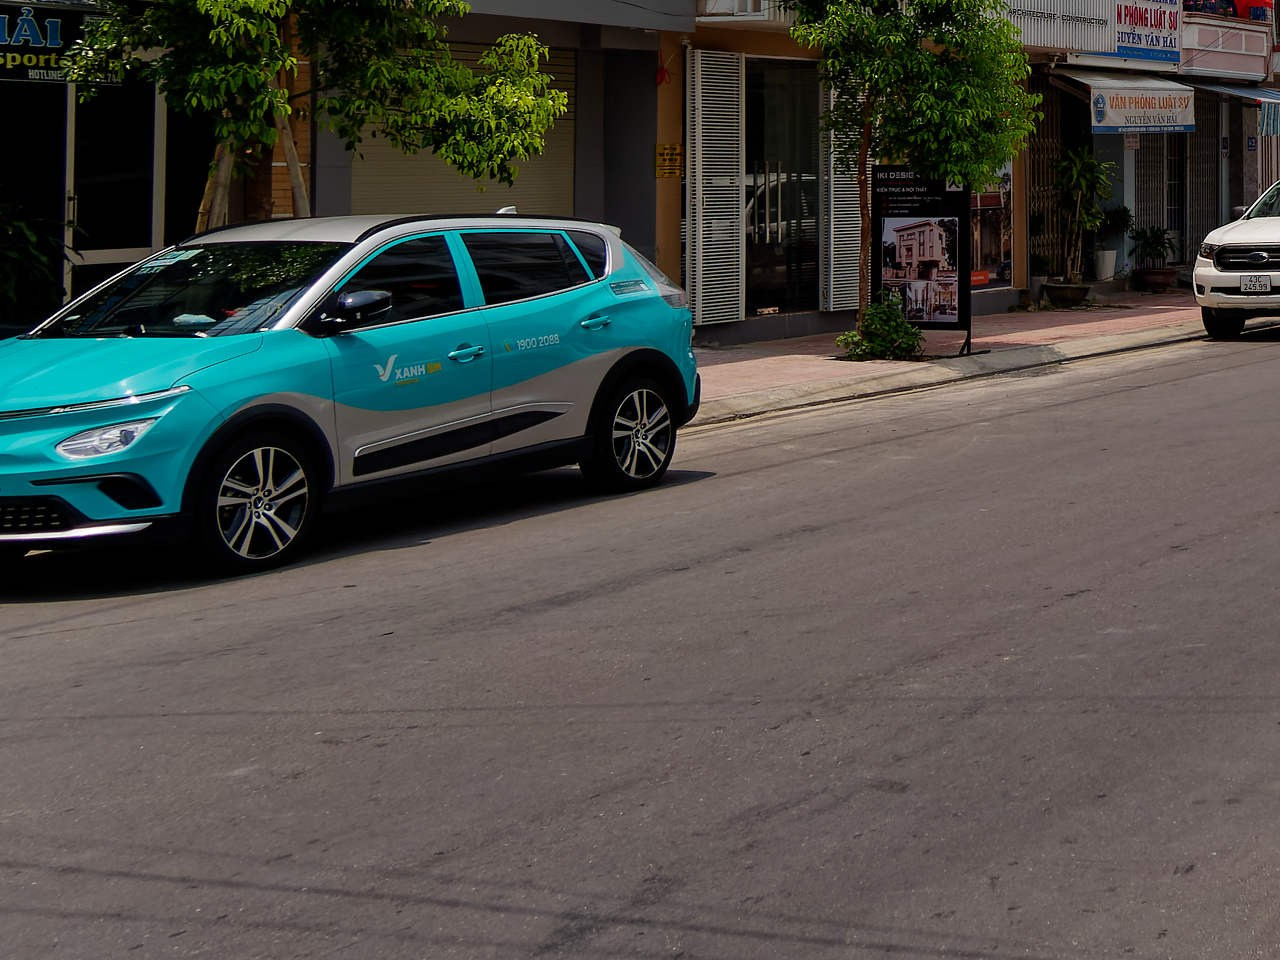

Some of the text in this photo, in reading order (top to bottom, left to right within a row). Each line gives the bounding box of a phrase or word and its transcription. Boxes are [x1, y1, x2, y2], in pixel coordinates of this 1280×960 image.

[1061, 14, 1108, 27] CONSTRUCTION
[1124, 1, 1149, 27] PHÒNG
[1150, 6, 1166, 33] LUẬT
[1128, 93, 1156, 110] PHÒNG
[517, 338, 537, 350] 1900
[394, 363, 426, 380] XANH
